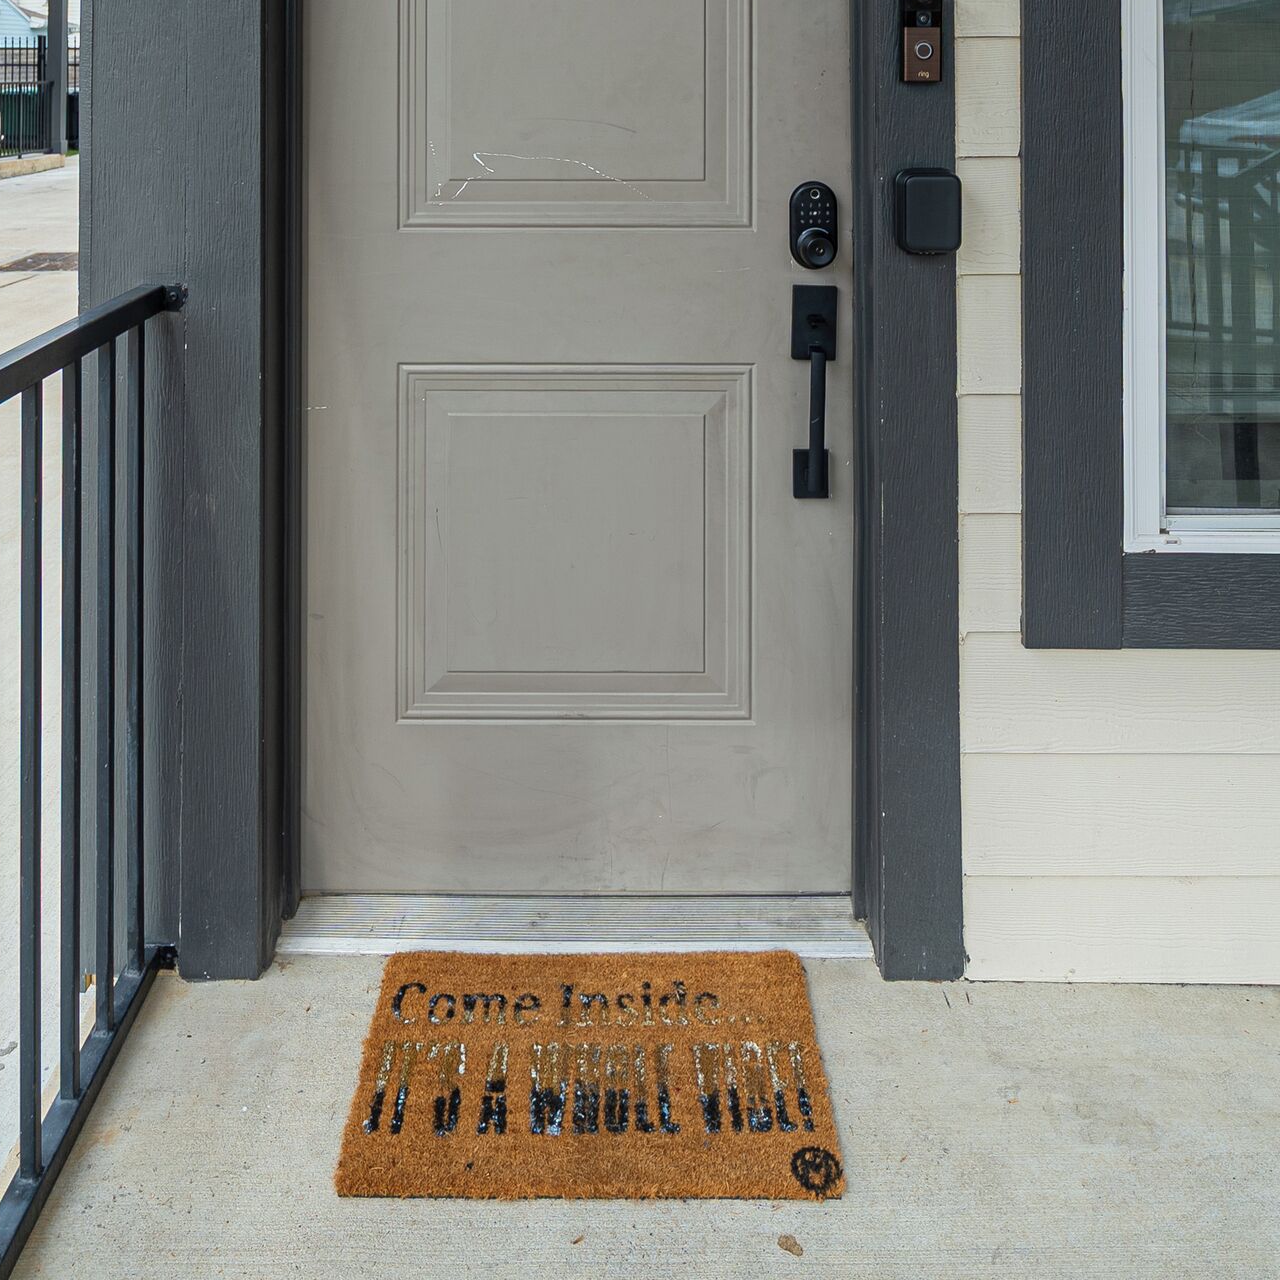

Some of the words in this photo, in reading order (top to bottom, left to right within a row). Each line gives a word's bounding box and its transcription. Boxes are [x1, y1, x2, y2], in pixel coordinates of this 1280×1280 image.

[917, 70, 930, 79] ring
[391, 981, 540, 1025] Come
[476, 1040, 509, 1136] A
